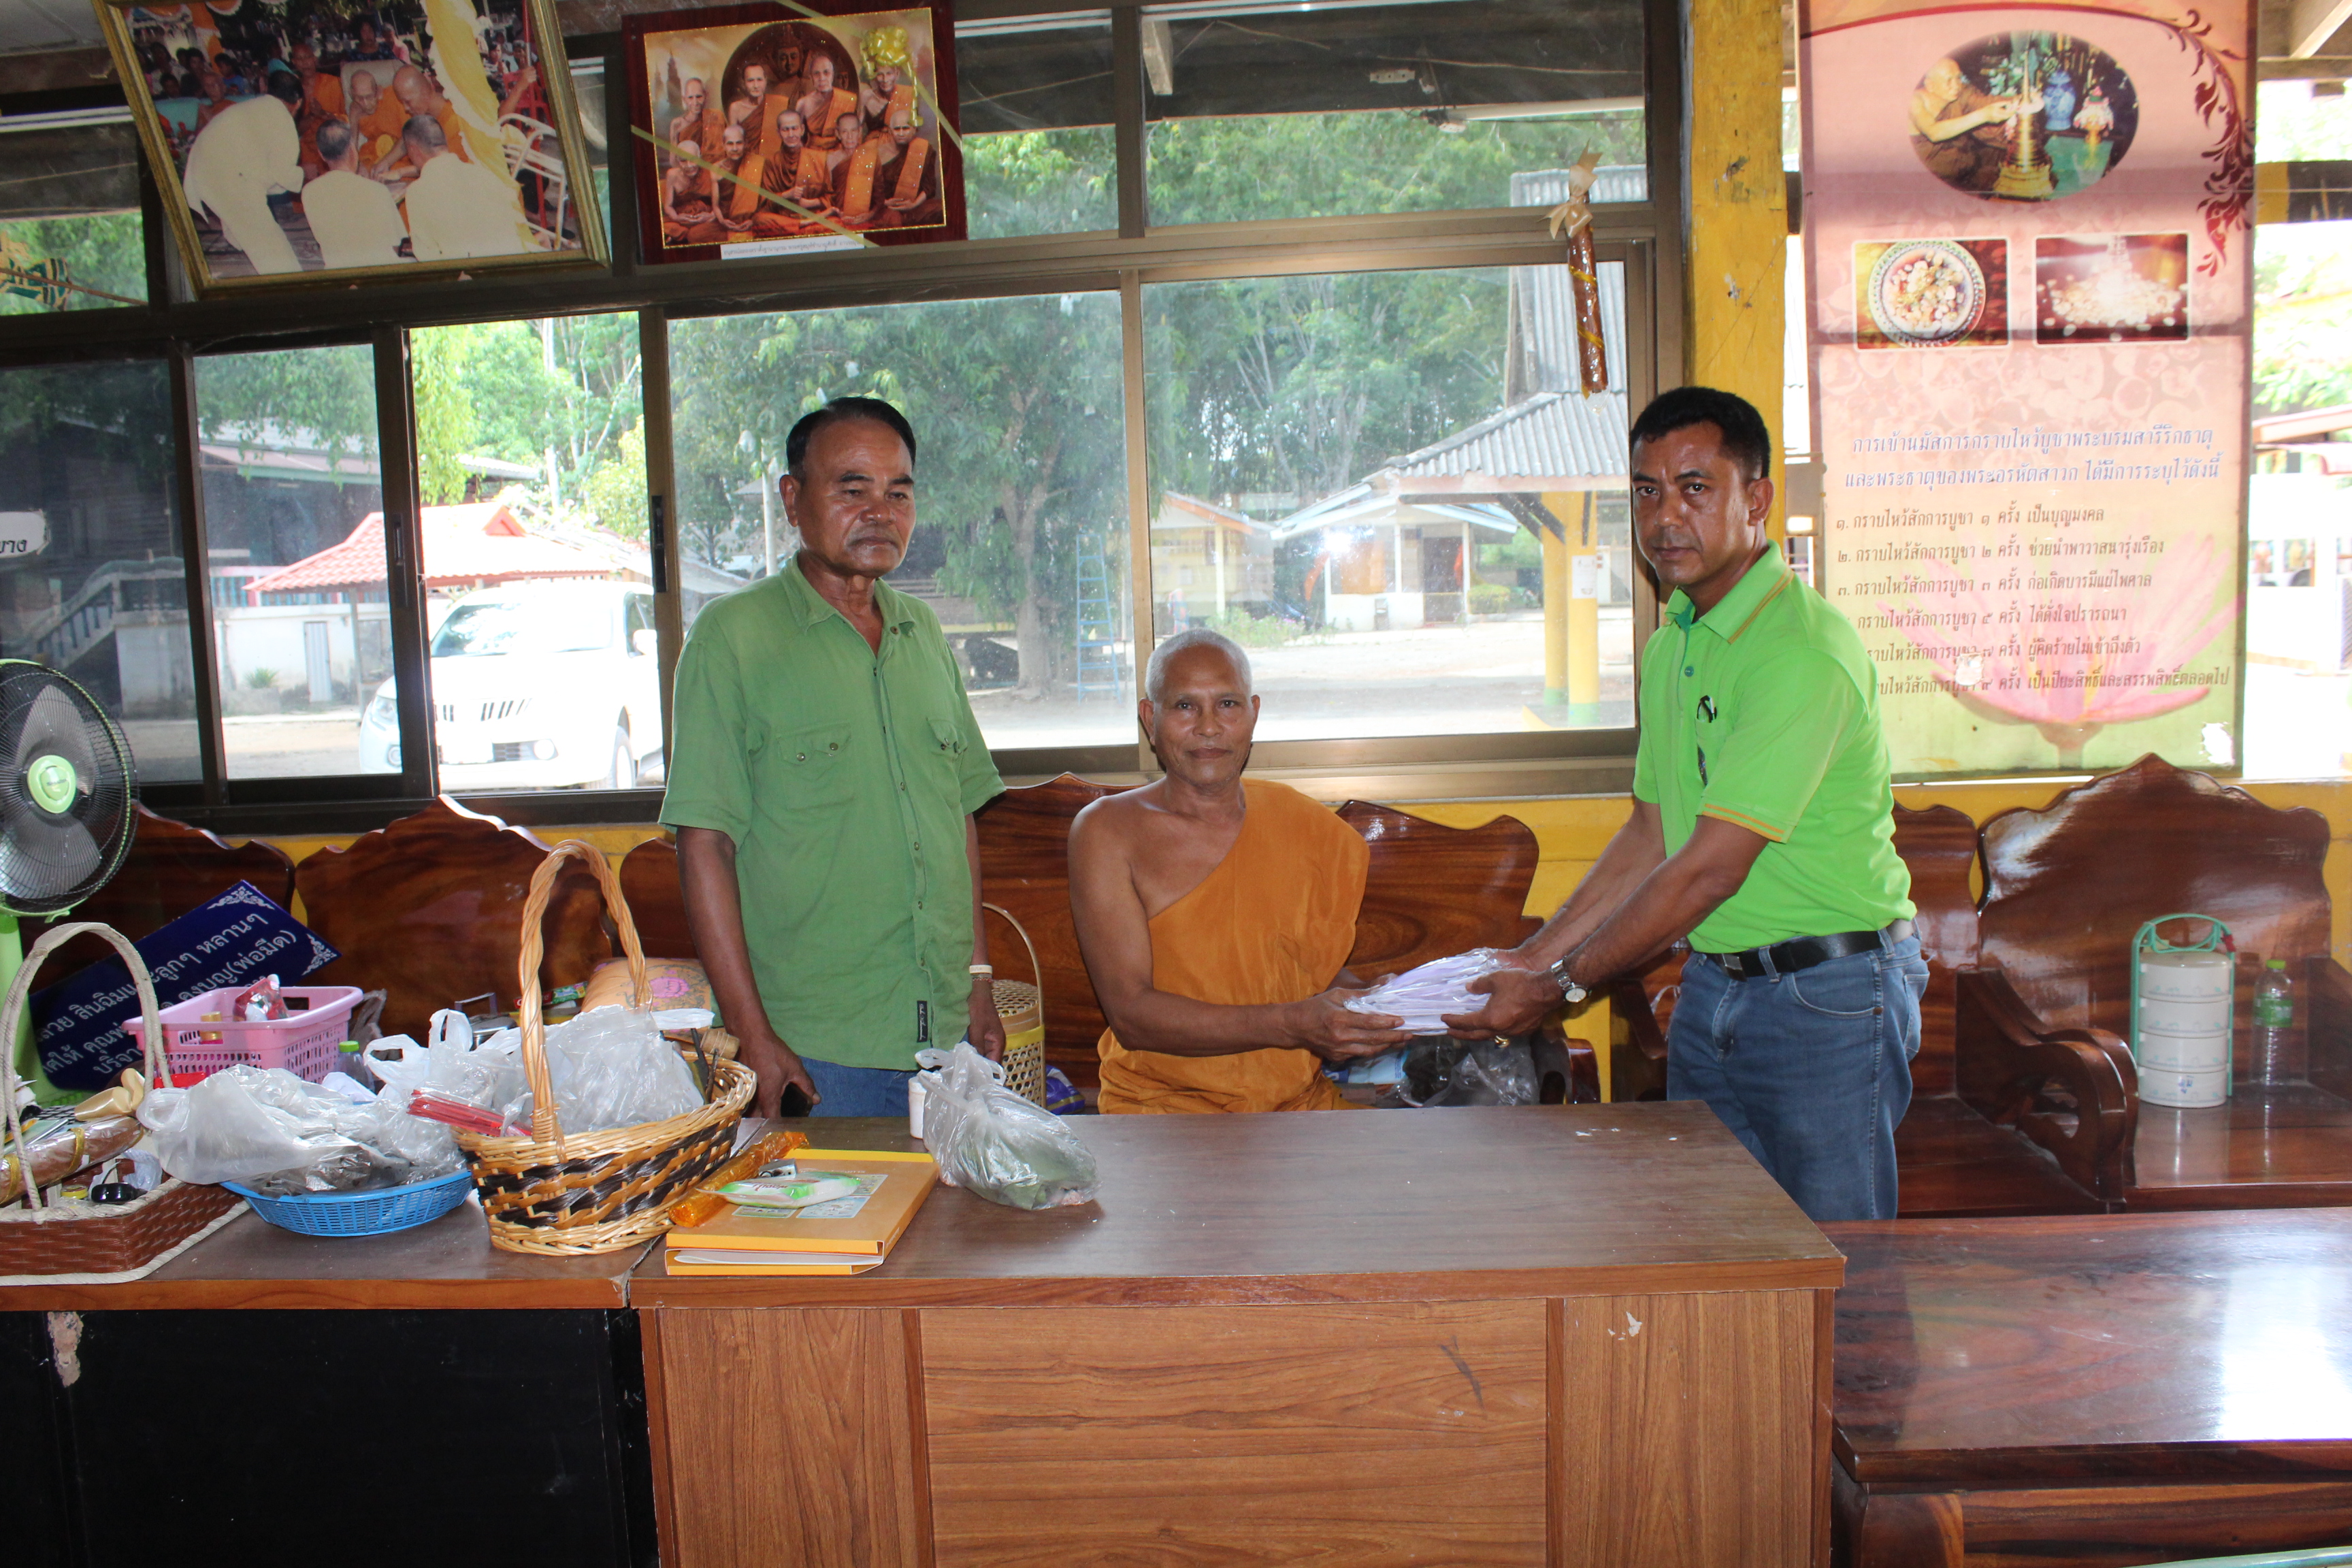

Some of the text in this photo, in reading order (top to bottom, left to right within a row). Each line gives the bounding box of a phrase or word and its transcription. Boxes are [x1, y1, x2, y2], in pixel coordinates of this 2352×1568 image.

[1854, 508, 1974, 531] กราบไหว้สักการบูชา
[1998, 500, 2021, 523] ครั้ง
[2027, 503, 2105, 527] เป็นบุญมงคล
[1856, 541, 1976, 565] กราบไหว้สักการบูชา
[1998, 534, 2021, 557] ครั้ง
[1855, 575, 1974, 598] กราบไหว้สักการบูชา
[1998, 567, 2021, 591] ครั้ง
[1858, 608, 1977, 632] กราบไหว้สักการบูชา
[1999, 600, 2021, 623] ครั้ง
[1867, 642, 1978, 665] ราบไหว้สักการบชา
[1999, 634, 2021, 657] ครั้ง
[1999, 666, 2021, 689] ครั้ง
[69, 952, 202, 1020] สินฉิมแะลูกๆ
[196, 913, 269, 953] หลานๆ
[42, 1044, 86, 1074] ศให้
[83, 1022, 128, 1055] คุณพ่
[93, 1047, 143, 1074] บริจา
